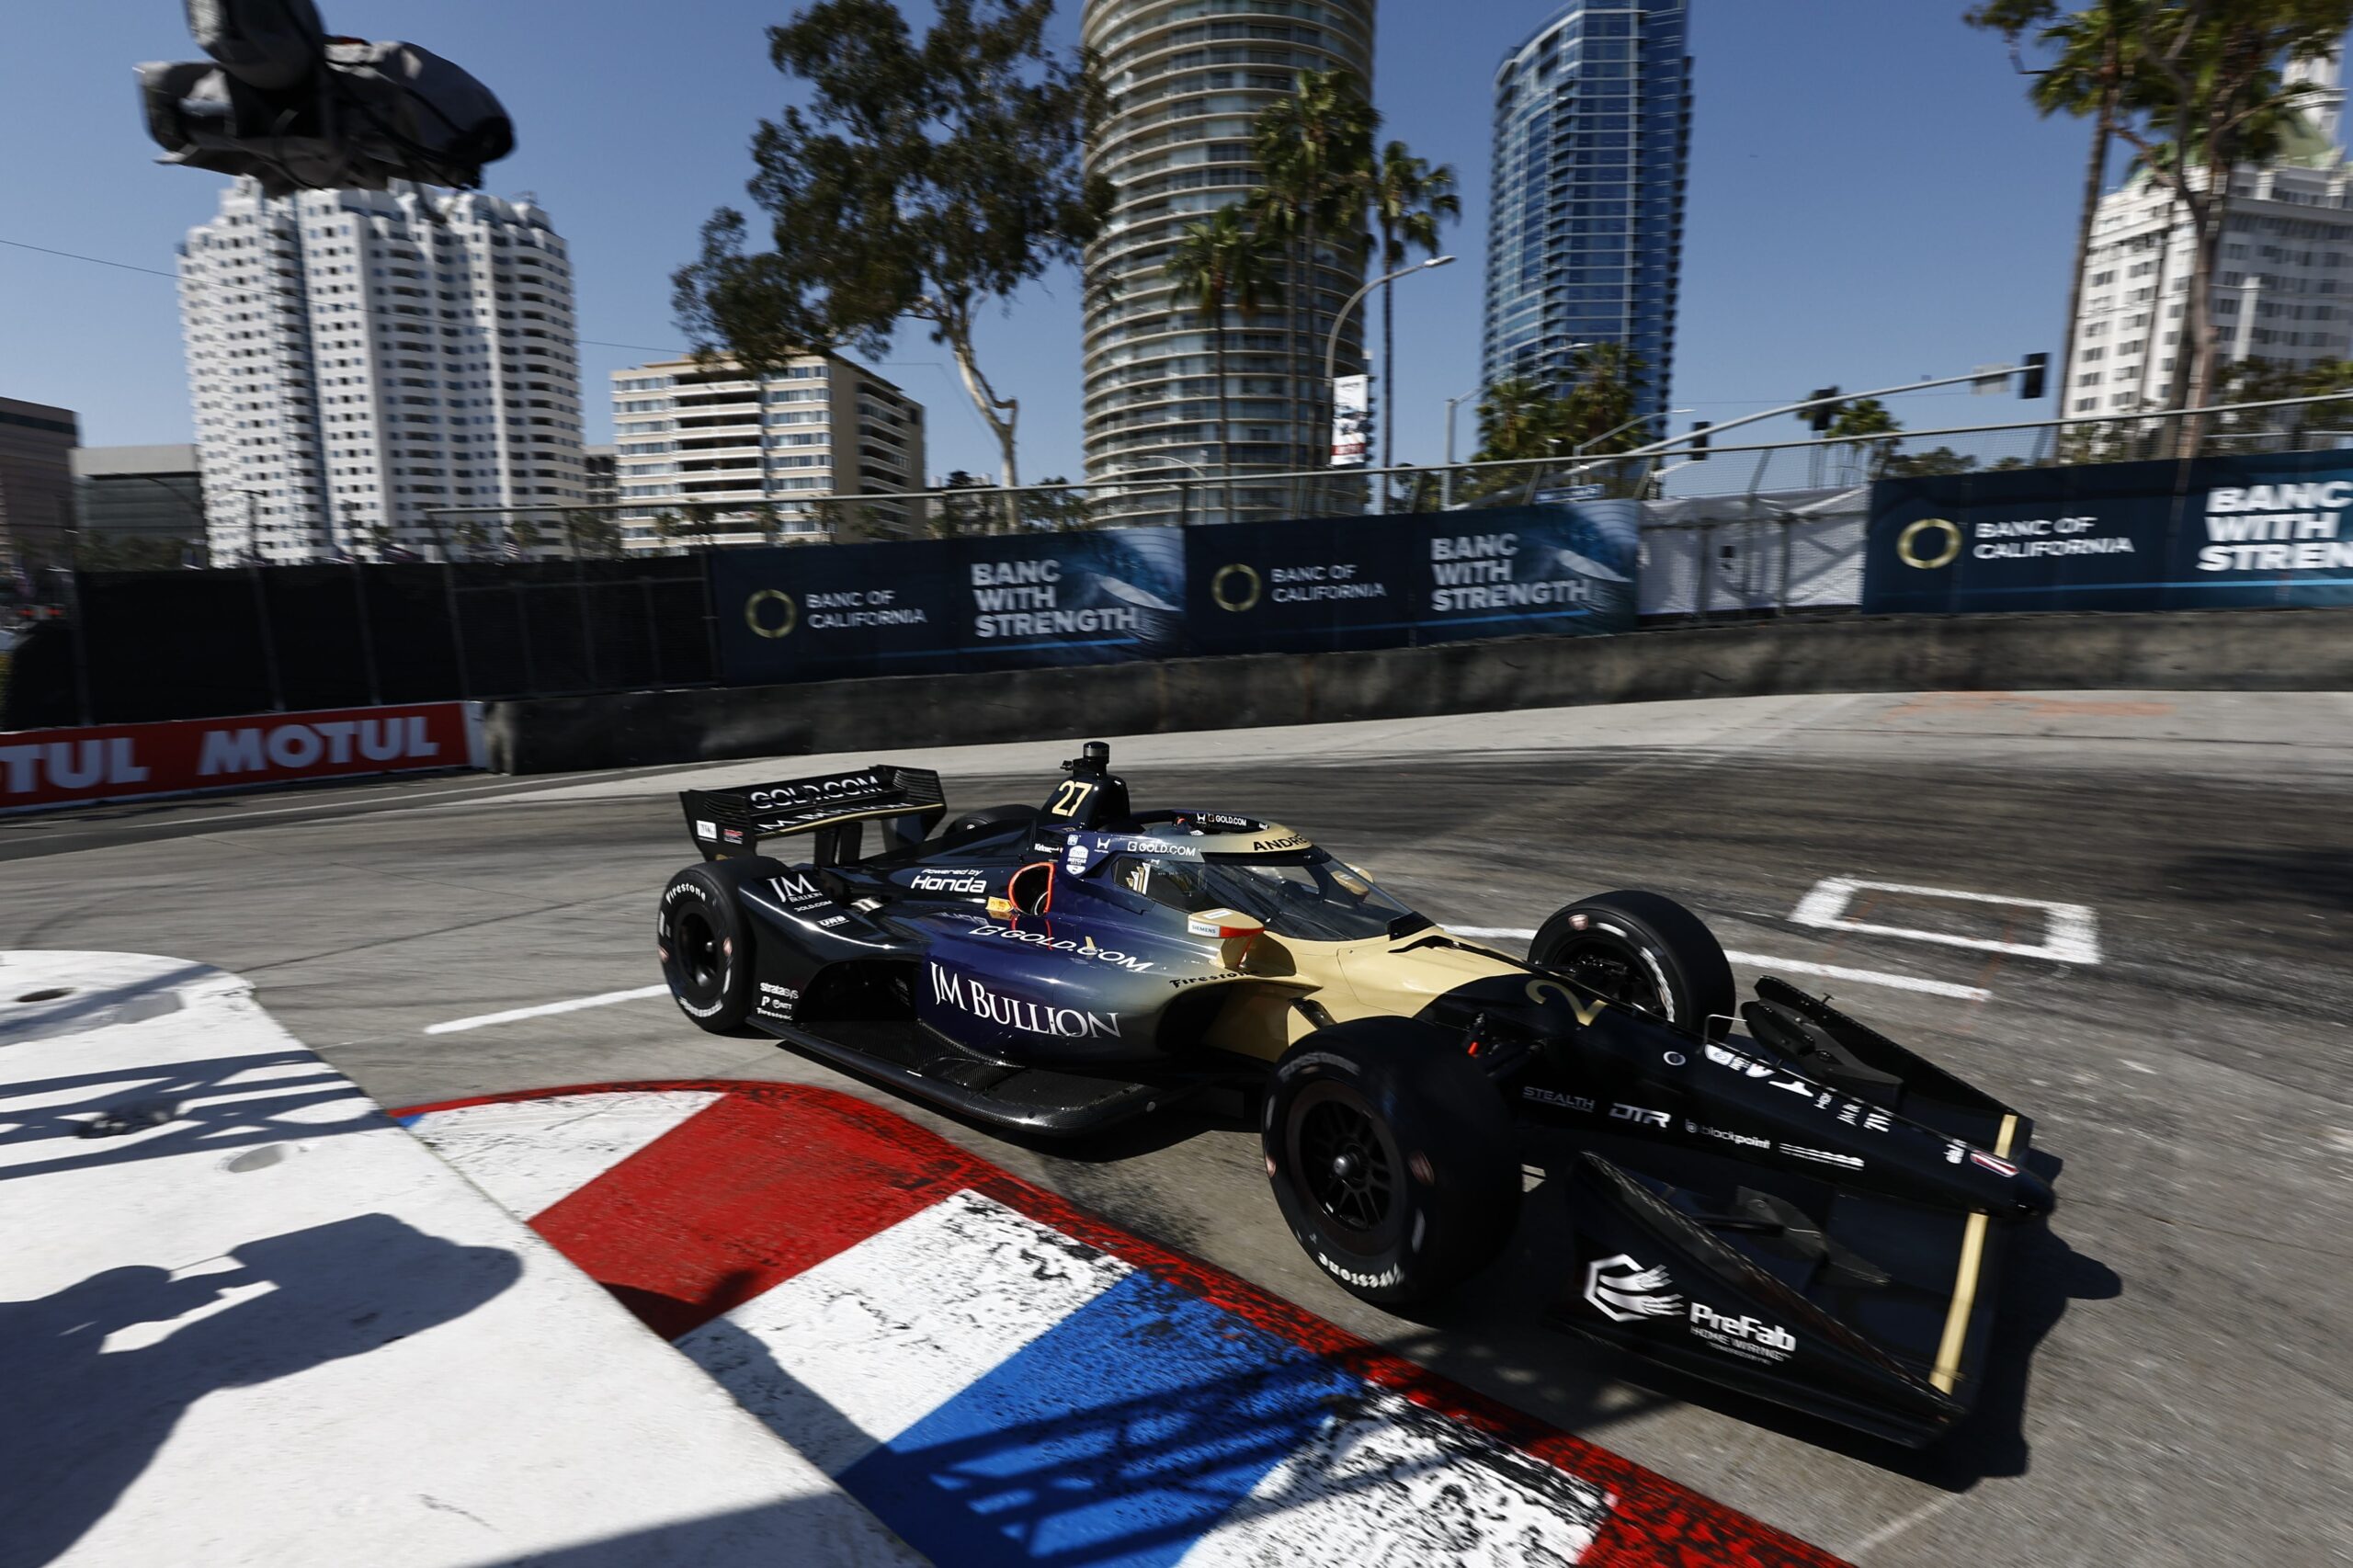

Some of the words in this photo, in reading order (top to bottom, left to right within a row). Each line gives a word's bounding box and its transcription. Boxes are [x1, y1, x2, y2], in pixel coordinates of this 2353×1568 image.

[2206, 481, 2353, 512] BANC
[1975, 519, 2052, 539] BANC
[2054, 517, 2097, 534] OF
[2205, 512, 2341, 541] WITH
[1430, 533, 1518, 561] BANC
[1973, 537, 2136, 559] CALIFORNIA
[970, 559, 1062, 586] BANC
[1271, 566, 1326, 584] BANC
[1329, 564, 1357, 580] OF
[1432, 558, 1513, 586] WITH
[806, 591, 864, 608] BANC
[866, 590, 895, 607] OF
[974, 585, 1056, 612] WITH
[1272, 583, 1387, 603] CALIFORNIA
[1431, 579, 1592, 612] STRENGTH
[808, 608, 928, 629] CALIFORNIA
[975, 607, 1139, 639] STRENGTH
[198, 716, 439, 776] MOTUL
[750, 775, 883, 810] GOLD.COM
[1051, 779, 1093, 817] 27
[1215, 814, 1247, 826] GOLD.COM
[1139, 842, 1196, 857] GOLD.COM
[665, 881, 707, 905] Firestone
[767, 873, 819, 903] JM
[910, 875, 987, 893] Honda
[1191, 925, 1216, 934] SIEMENS
[1000, 930, 1154, 972] GOLD.COM
[1169, 970, 1260, 989] Firestone
[930, 961, 968, 1011] JM
[968, 979, 1123, 1039] BULLION
[1523, 1086, 1596, 1109] STEALTH
[1690, 1301, 1797, 1352] PreFab
